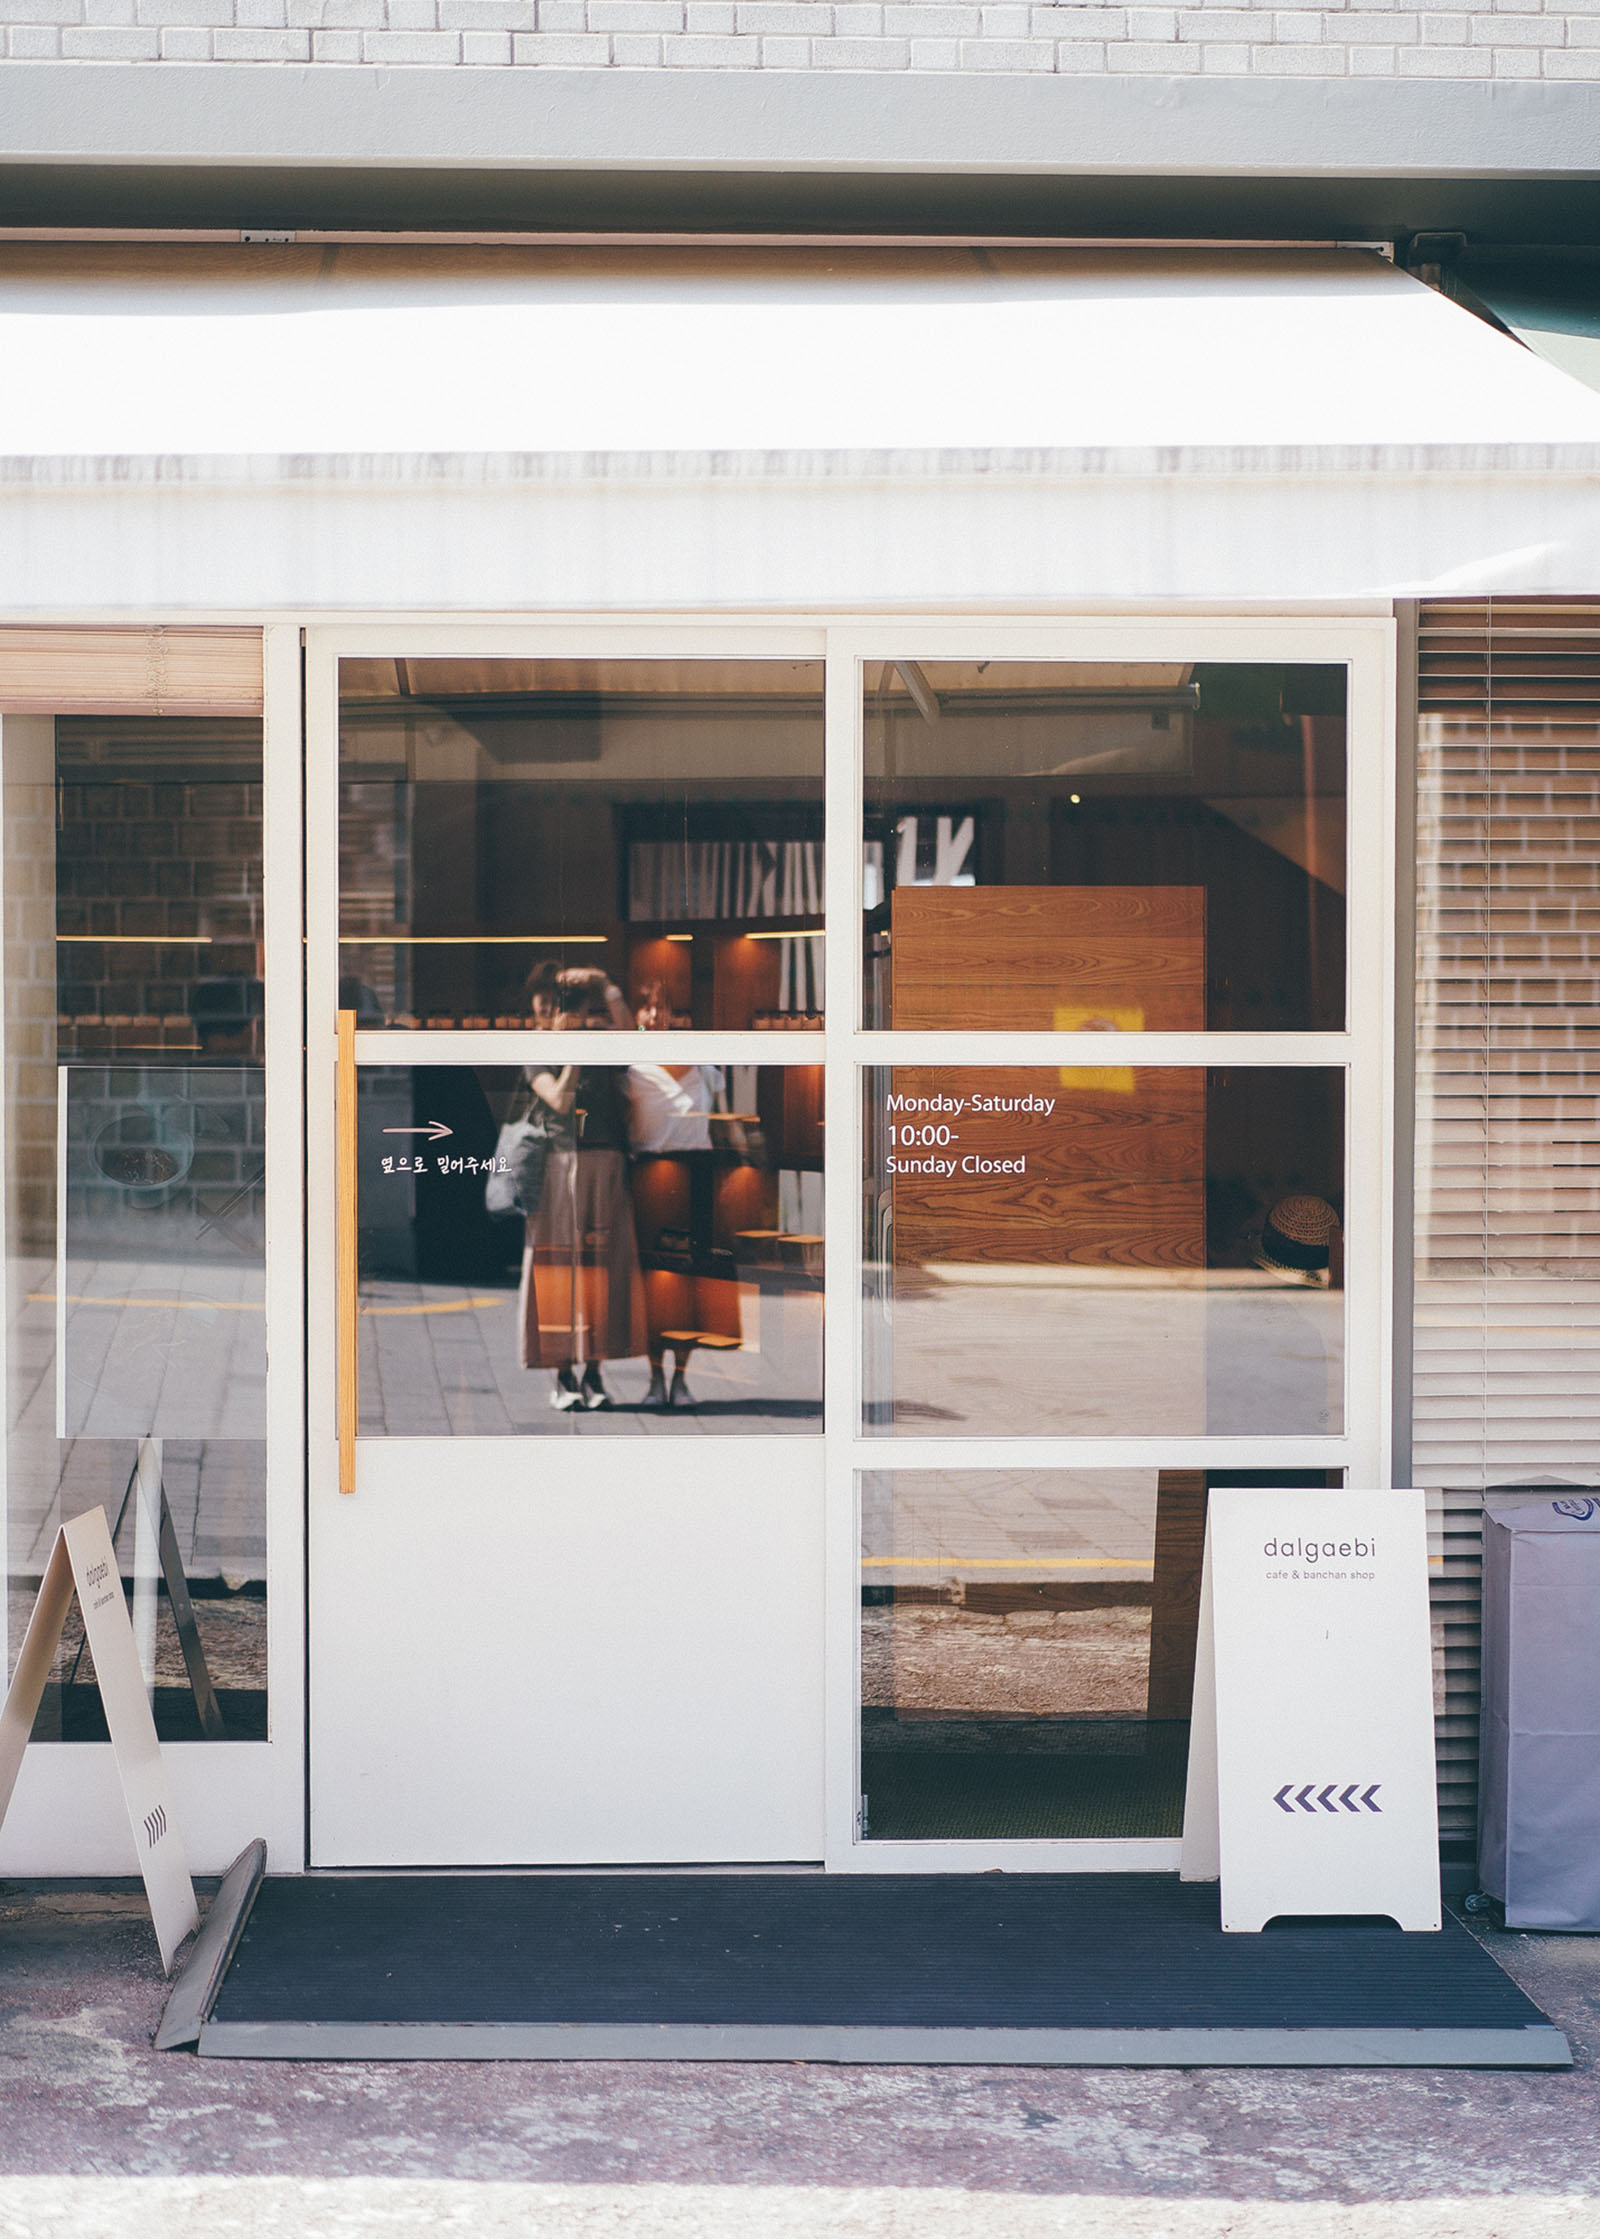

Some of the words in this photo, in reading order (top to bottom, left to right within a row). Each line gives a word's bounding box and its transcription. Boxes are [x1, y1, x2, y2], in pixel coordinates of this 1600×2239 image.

[886, 1093, 1056, 1117] Monday-Saturday
[888, 1124, 960, 1146] 10:00-
[380, 1155, 429, 1175] 옆으로
[436, 1154, 513, 1175] 밀어주세요
[886, 1155, 957, 1178] Sunday
[961, 1155, 1026, 1174] Closed
[1263, 1537, 1376, 1564] dalgaebi
[1265, 1569, 1289, 1580] cafe
[1291, 1569, 1300, 1580] &
[1303, 1569, 1347, 1580] banchan
[1350, 1569, 1376, 1581] shop
